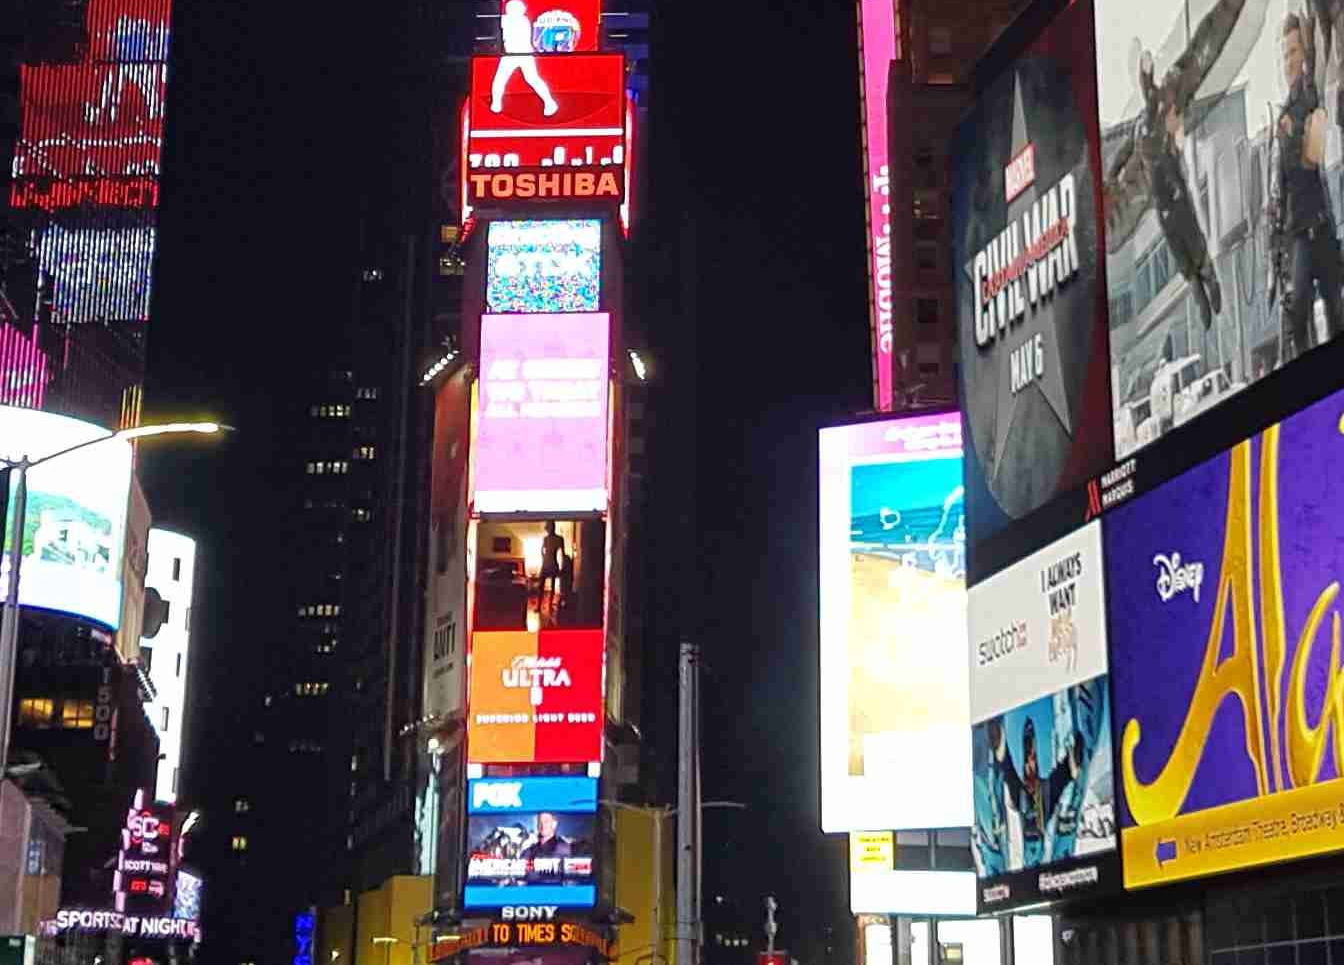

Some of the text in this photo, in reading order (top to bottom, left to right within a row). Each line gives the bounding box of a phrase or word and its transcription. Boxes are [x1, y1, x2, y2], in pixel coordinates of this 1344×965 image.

[470, 172, 620, 198] TOSHIBA
[974, 172, 1080, 347] CIVIL WAR
[1010, 333, 1044, 395] MAY 6
[1100, 459, 1137, 489] MARRIOTT
[1101, 480, 1135, 508] MARQUIS
[1048, 582, 1077, 616] WANT
[501, 668, 572, 688] ULTRA
[473, 782, 523, 809] FOX
[1290, 808, 1339, 836] Broadway
[122, 916, 140, 934] AT
[501, 905, 559, 920] SONY
[493, 923, 510, 942] TO
[516, 922, 554, 943] TIMES
